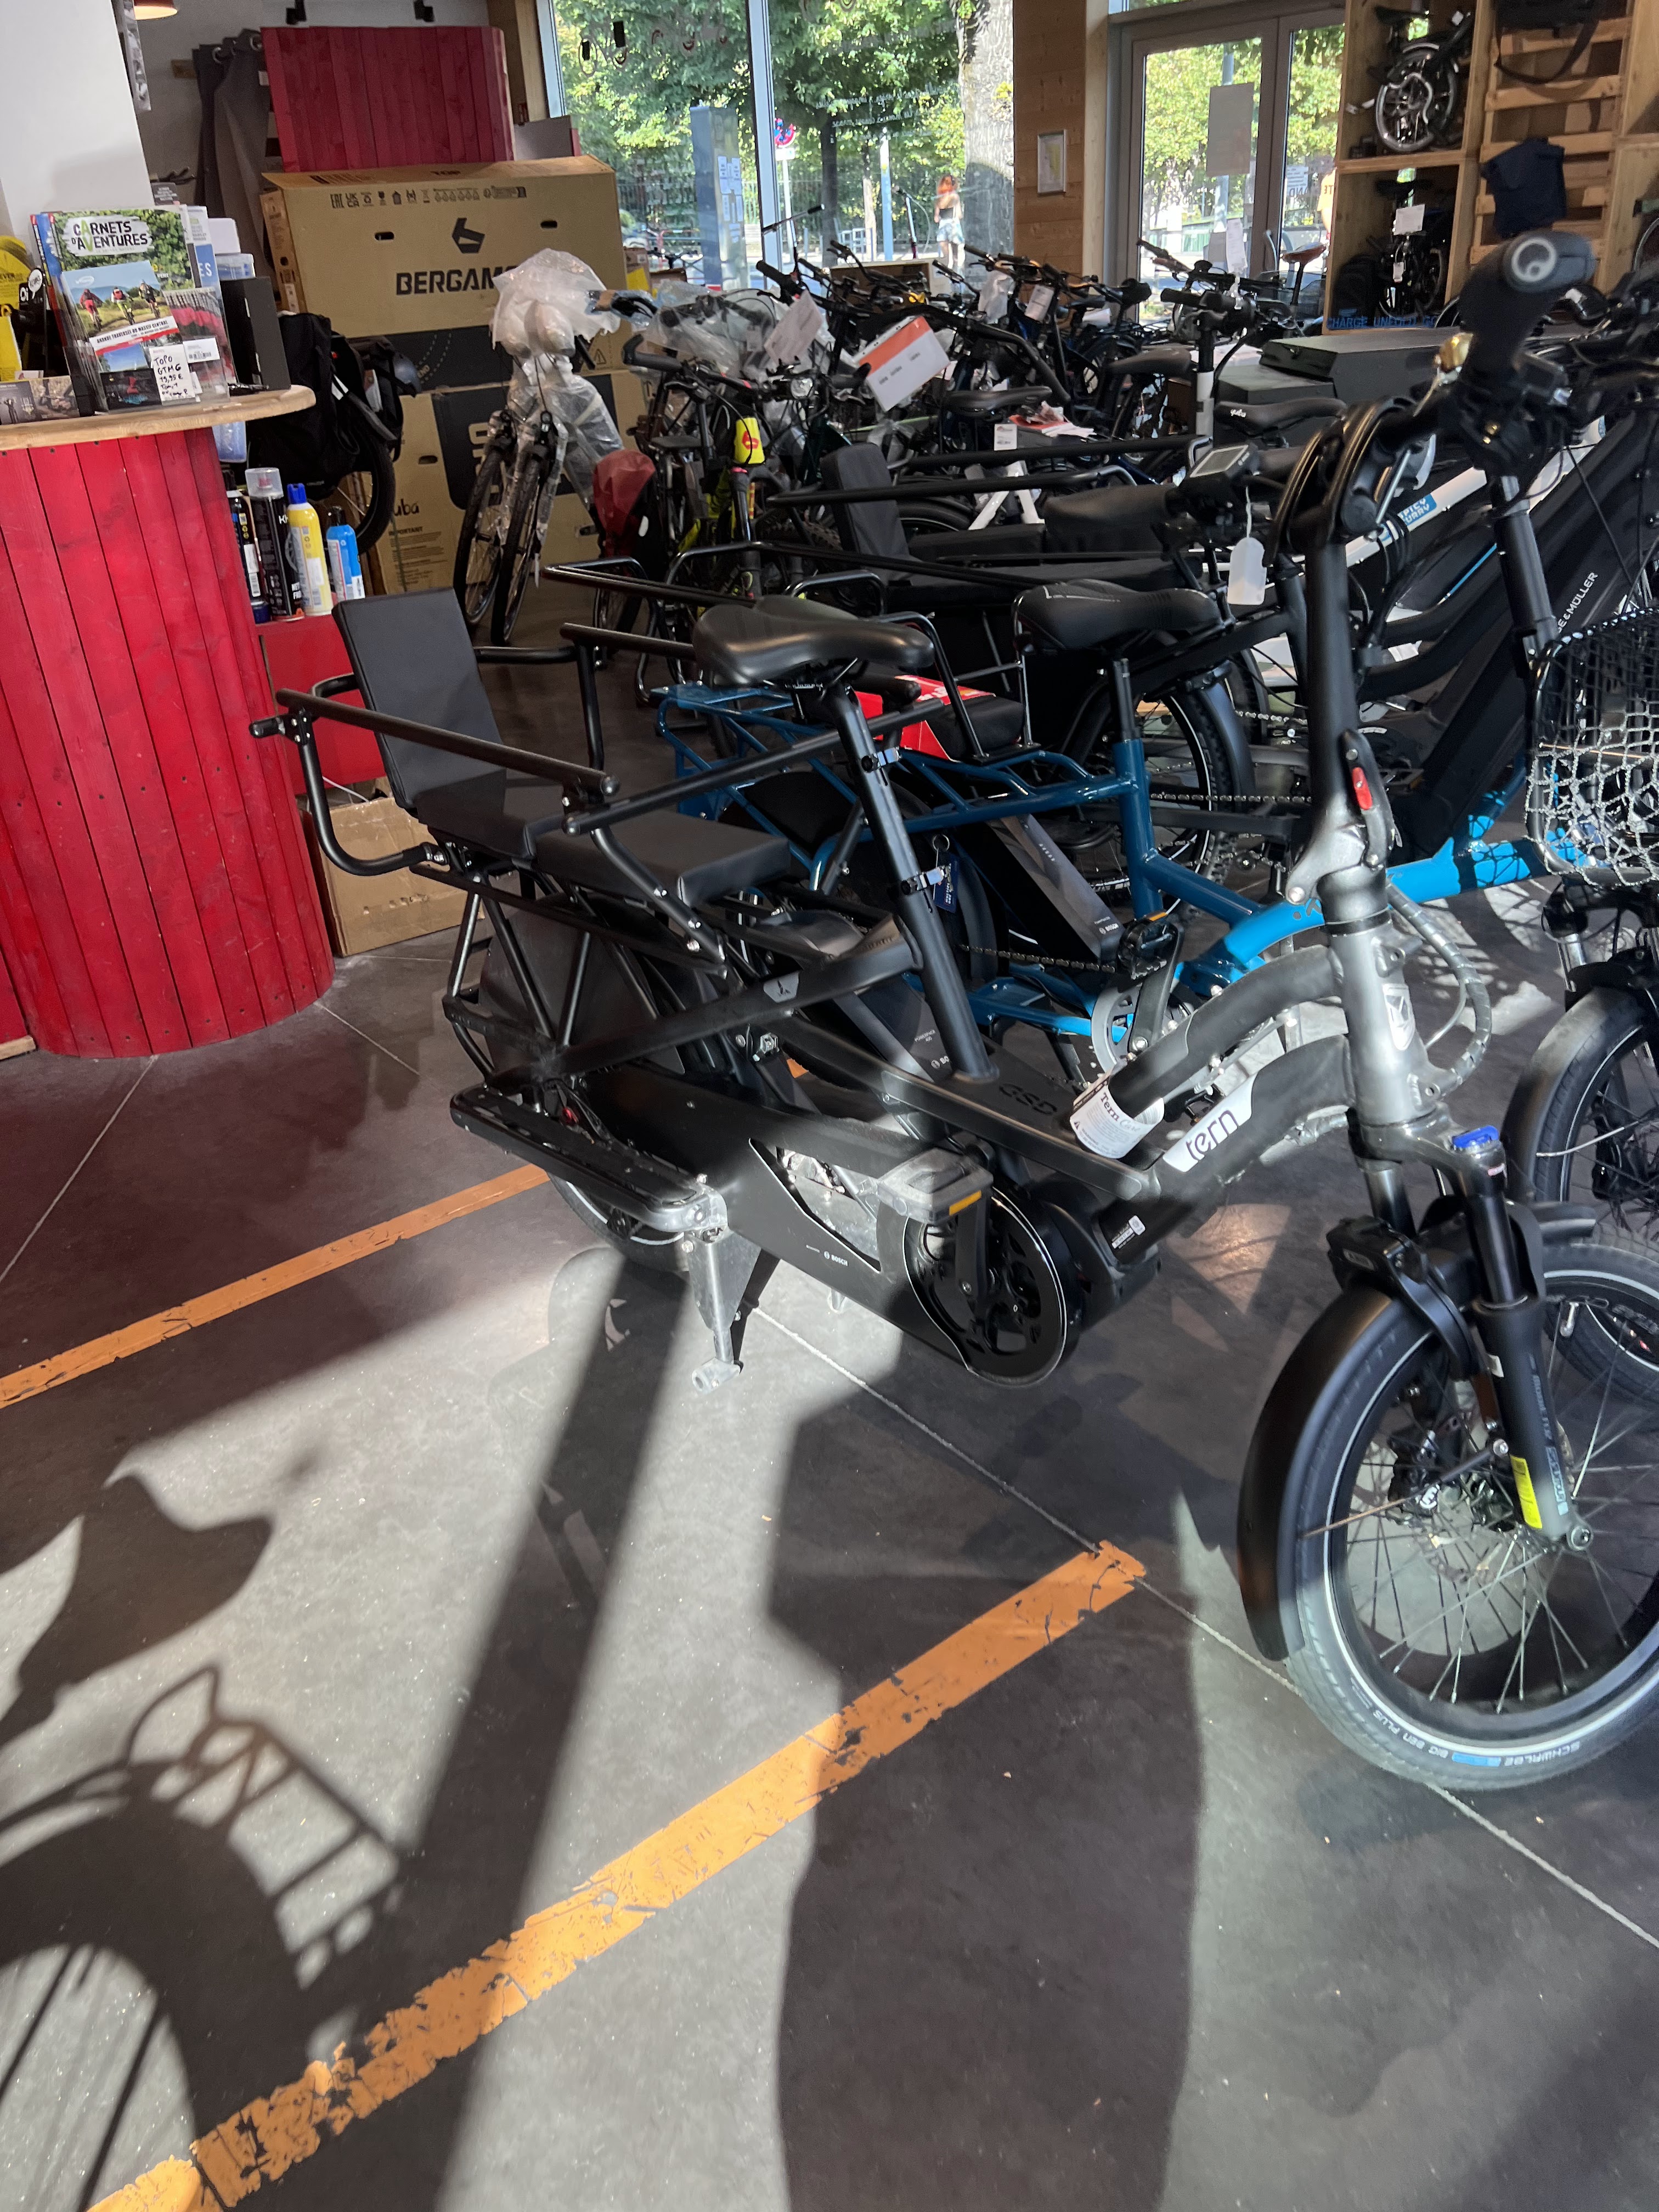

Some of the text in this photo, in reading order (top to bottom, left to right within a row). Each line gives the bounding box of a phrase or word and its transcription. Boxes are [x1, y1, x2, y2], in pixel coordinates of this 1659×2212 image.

[73, 218, 132, 236] CARNETS
[396, 265, 518, 296] BERGAM
[1327, 316, 1368, 330] CHARGE
[155, 354, 173, 367] TOPO
[393, 497, 420, 517] uba
[1404, 503, 1430, 523] URRY
[939, 1055, 950, 1065] BO
[998, 1082, 1058, 1115] GSD
[1101, 1092, 1120, 1122] Tern
[1186, 1109, 1240, 1162] tern
[831, 1254, 848, 1267] BOSCH
[1373, 1709, 1401, 1735] PLUS
[1504, 1741, 1581, 1767] SCHWALBE
